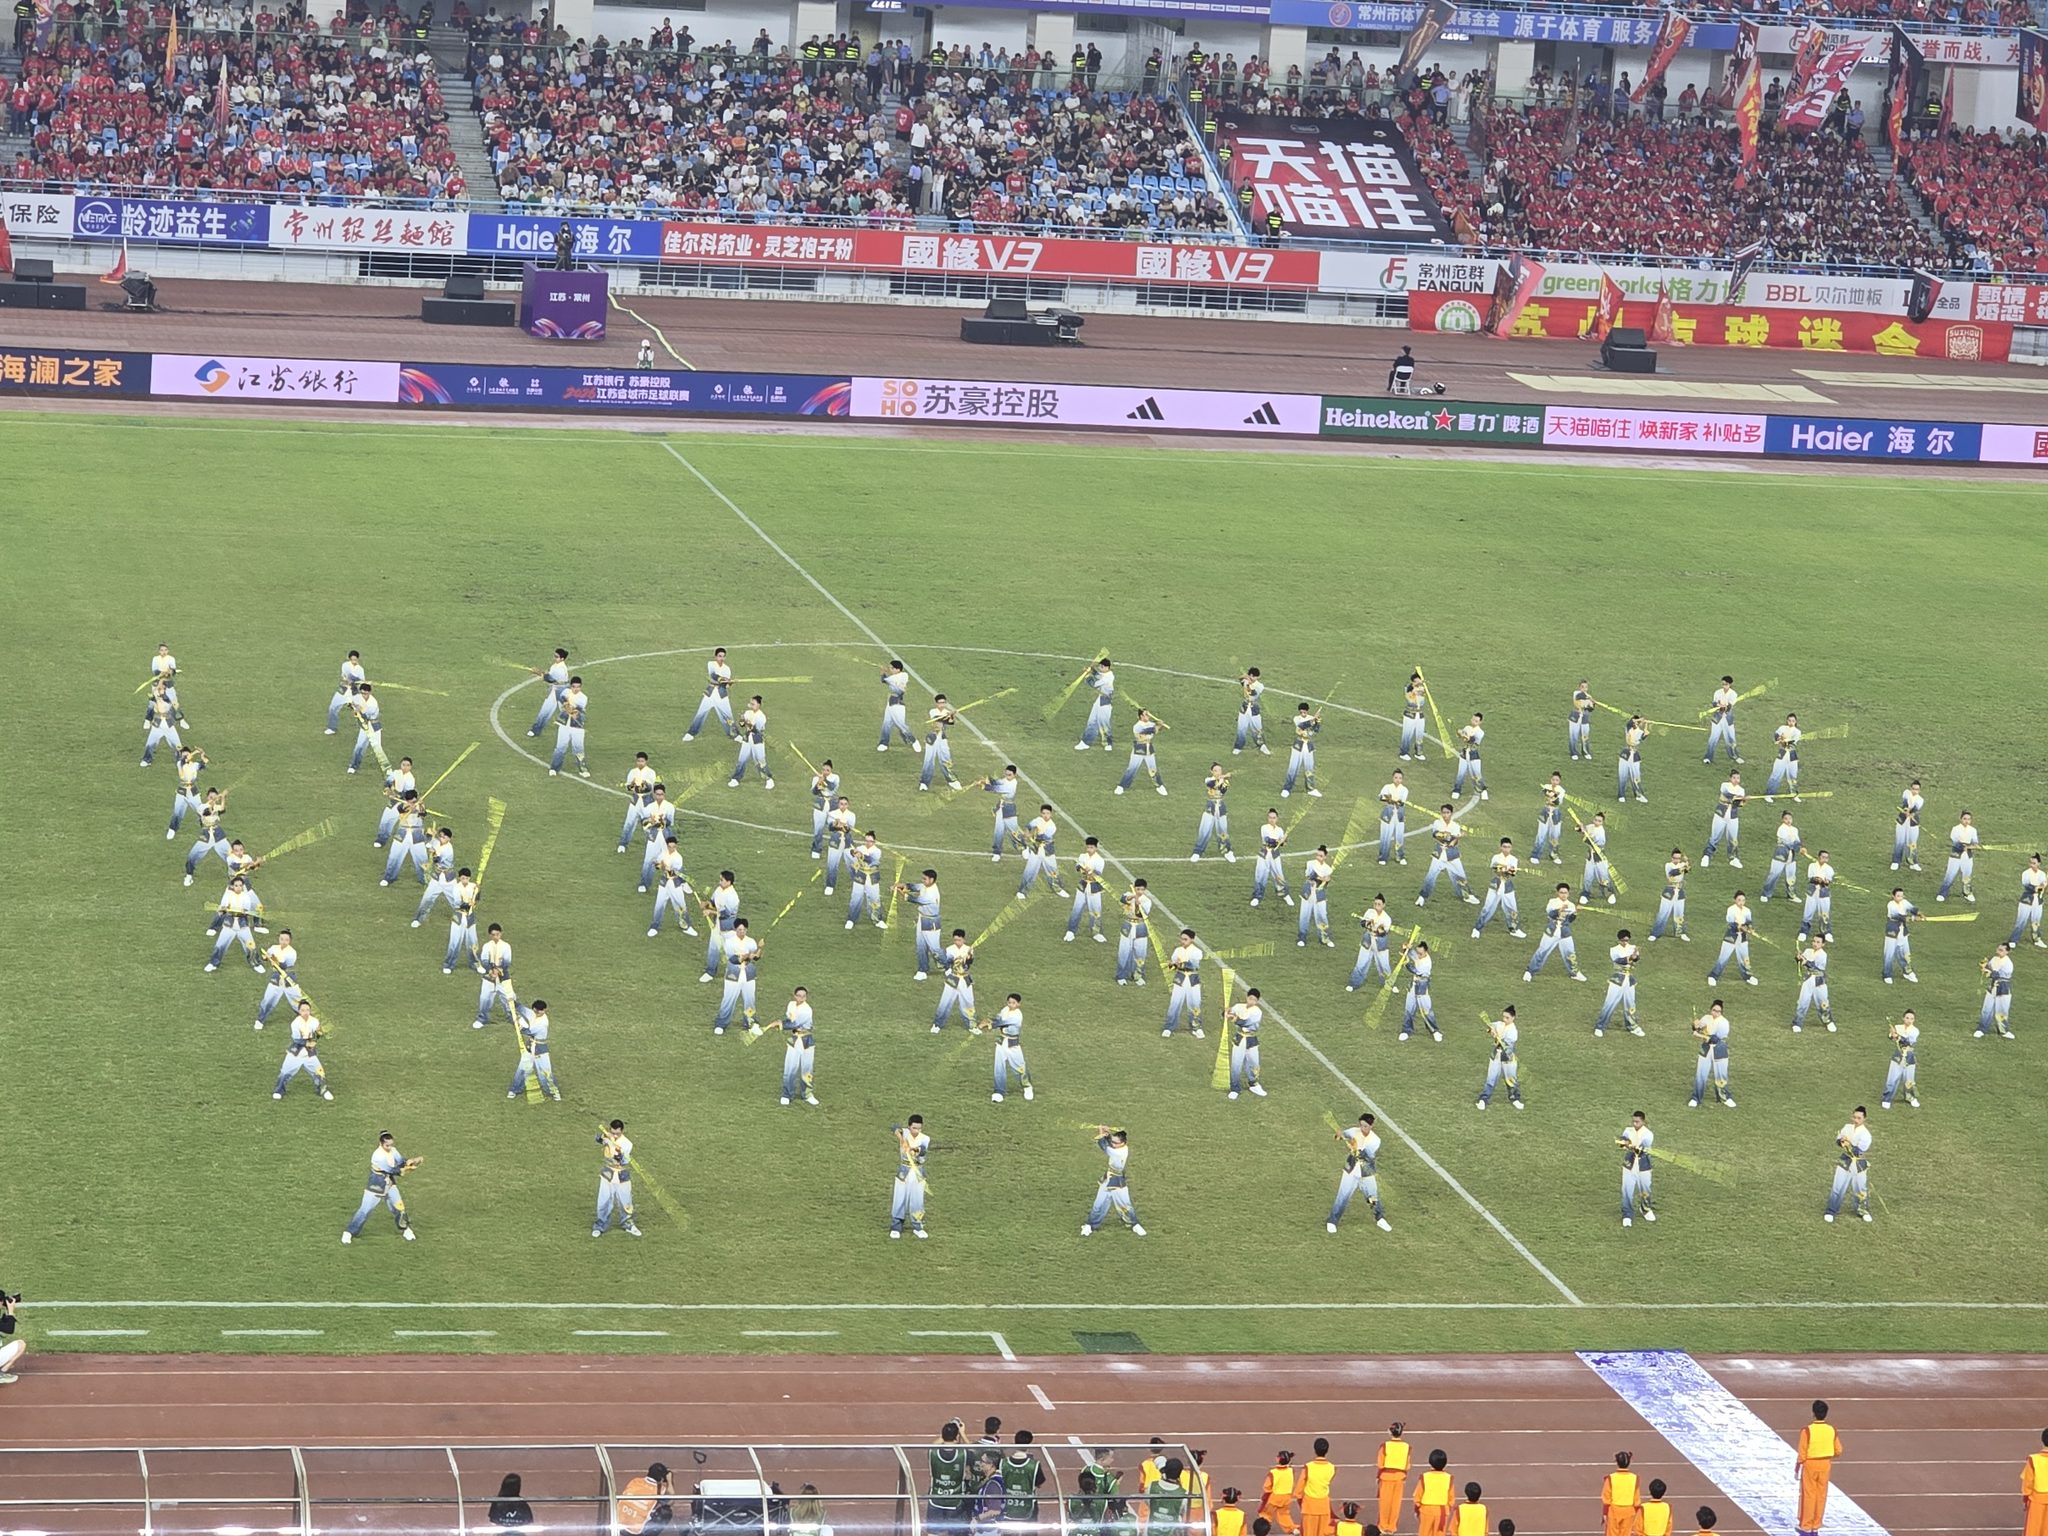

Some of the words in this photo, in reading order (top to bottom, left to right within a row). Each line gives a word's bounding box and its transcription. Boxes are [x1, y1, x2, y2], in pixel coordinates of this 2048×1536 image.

[1513, 14, 1602, 41] 源于体育
[1236, 137, 1411, 186] 天猫
[9, 203, 60, 224] 保险
[121, 203, 227, 240] 龄迹益生
[1254, 183, 1436, 232] 喵住
[496, 223, 558, 251] Haie
[574, 224, 632, 254] 海尔
[1418, 263, 1485, 280] 常州范群
[1417, 280, 1484, 292] FANQUN
[1765, 284, 1812, 303] BBL
[1815, 286, 1883, 306] 贝尔地板
[1949, 329, 1980, 337] SUZHOU
[0, 354, 122, 387] 海澜之家
[923, 385, 1060, 419] 苏豪控股
[1325, 407, 1430, 431] Heineken
[1458, 413, 1495, 432] 喜力
[1502, 415, 1540, 434] 啤酒
[1548, 415, 1632, 440] 天猫喵住
[1638, 419, 1698, 441] 焕新家
[1702, 422, 1761, 444] 补贴多
[1791, 424, 1874, 451] Haier
[1887, 425, 1955, 455] 海尔
